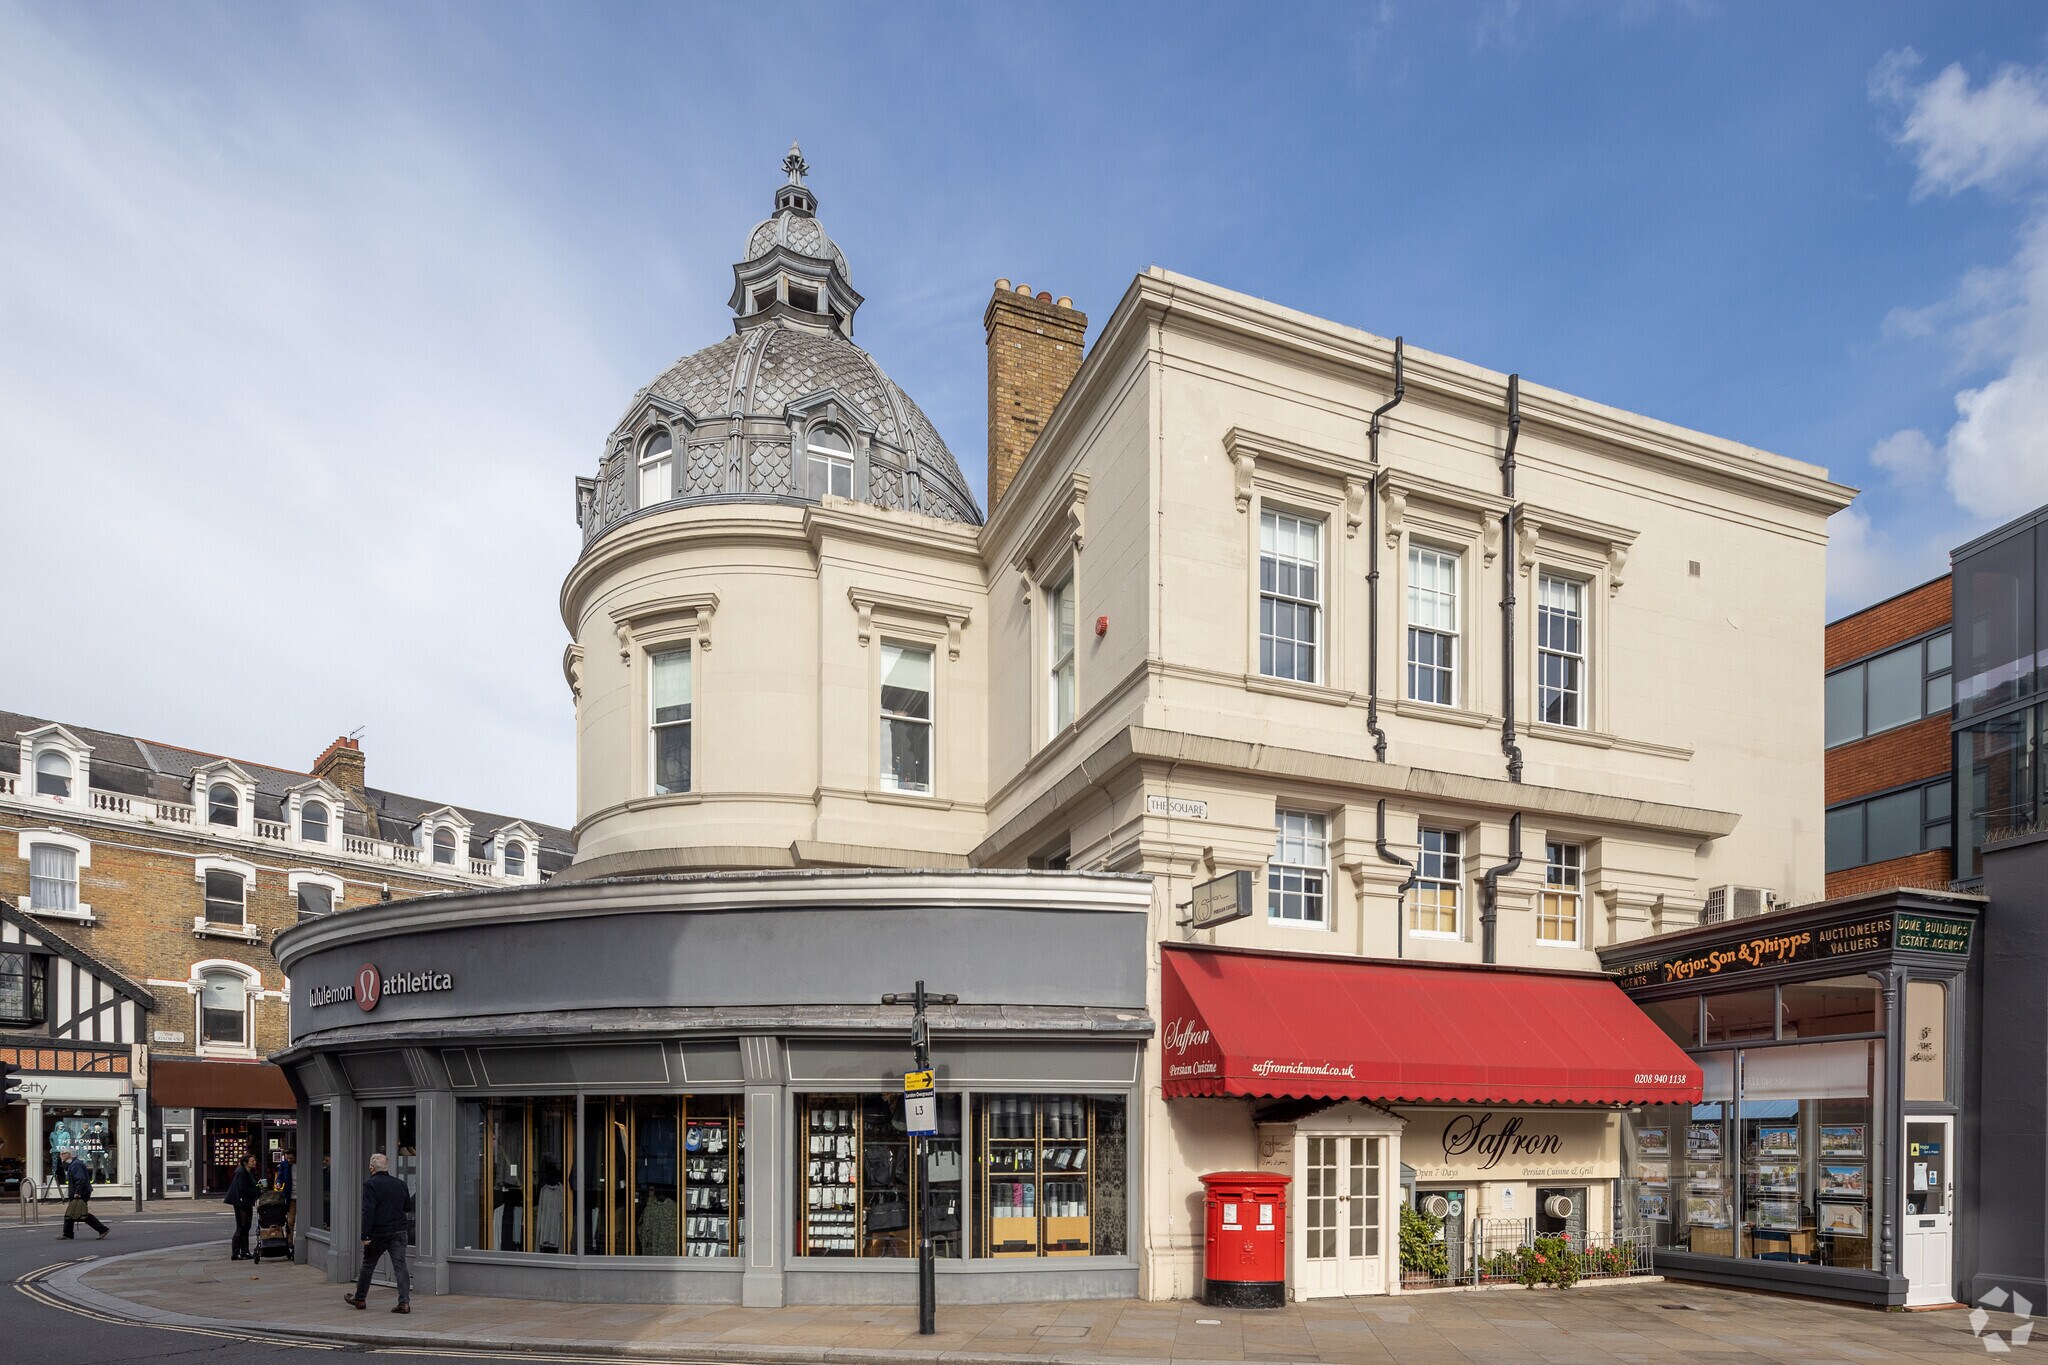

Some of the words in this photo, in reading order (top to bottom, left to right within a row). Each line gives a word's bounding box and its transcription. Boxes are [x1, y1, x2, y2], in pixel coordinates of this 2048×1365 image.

[1151, 800, 1168, 812] THE
[1169, 801, 1204, 815] SQUARE
[1819, 919, 1892, 943] AUCTIONEERS
[1898, 919, 1921, 932] DOME
[1925, 921, 1968, 937] BUILDINGS
[1830, 936, 1879, 955] VALUERS
[1900, 934, 1928, 948] ESTATE
[1932, 937, 1965, 951] AGENCY
[1709, 951, 1736, 974] Son
[1737, 943, 1753, 963] &
[1750, 931, 1811, 967] Phipps
[1634, 960, 1659, 974] ESTATE
[309, 985, 353, 1008] lululemon
[382, 970, 452, 996] athletica
[1620, 975, 1648, 988] AGENTS
[1164, 1016, 1210, 1056] Saffron
[1169, 1063, 1192, 1077] Persian
[1193, 1060, 1217, 1075] Cuisine
[1251, 1060, 1356, 1079] saffronrichmond.co.uk
[1634, 1074, 1653, 1085] 0208
[1653, 1074, 1668, 1085] 940
[1668, 1074, 1687, 1085] 1138
[915, 1105, 924, 1116] L3
[1442, 1112, 1563, 1170] Saffron
[1415, 1168, 1433, 1180] Open
[1435, 1168, 1441, 1177] 7
[1441, 1168, 1459, 1179] Days
[1521, 1167, 1546, 1177] Persian
[1546, 1166, 1570, 1177] Cuisine
[1570, 1166, 1579, 1176] &
[1579, 1165, 1594, 1177] Grill
